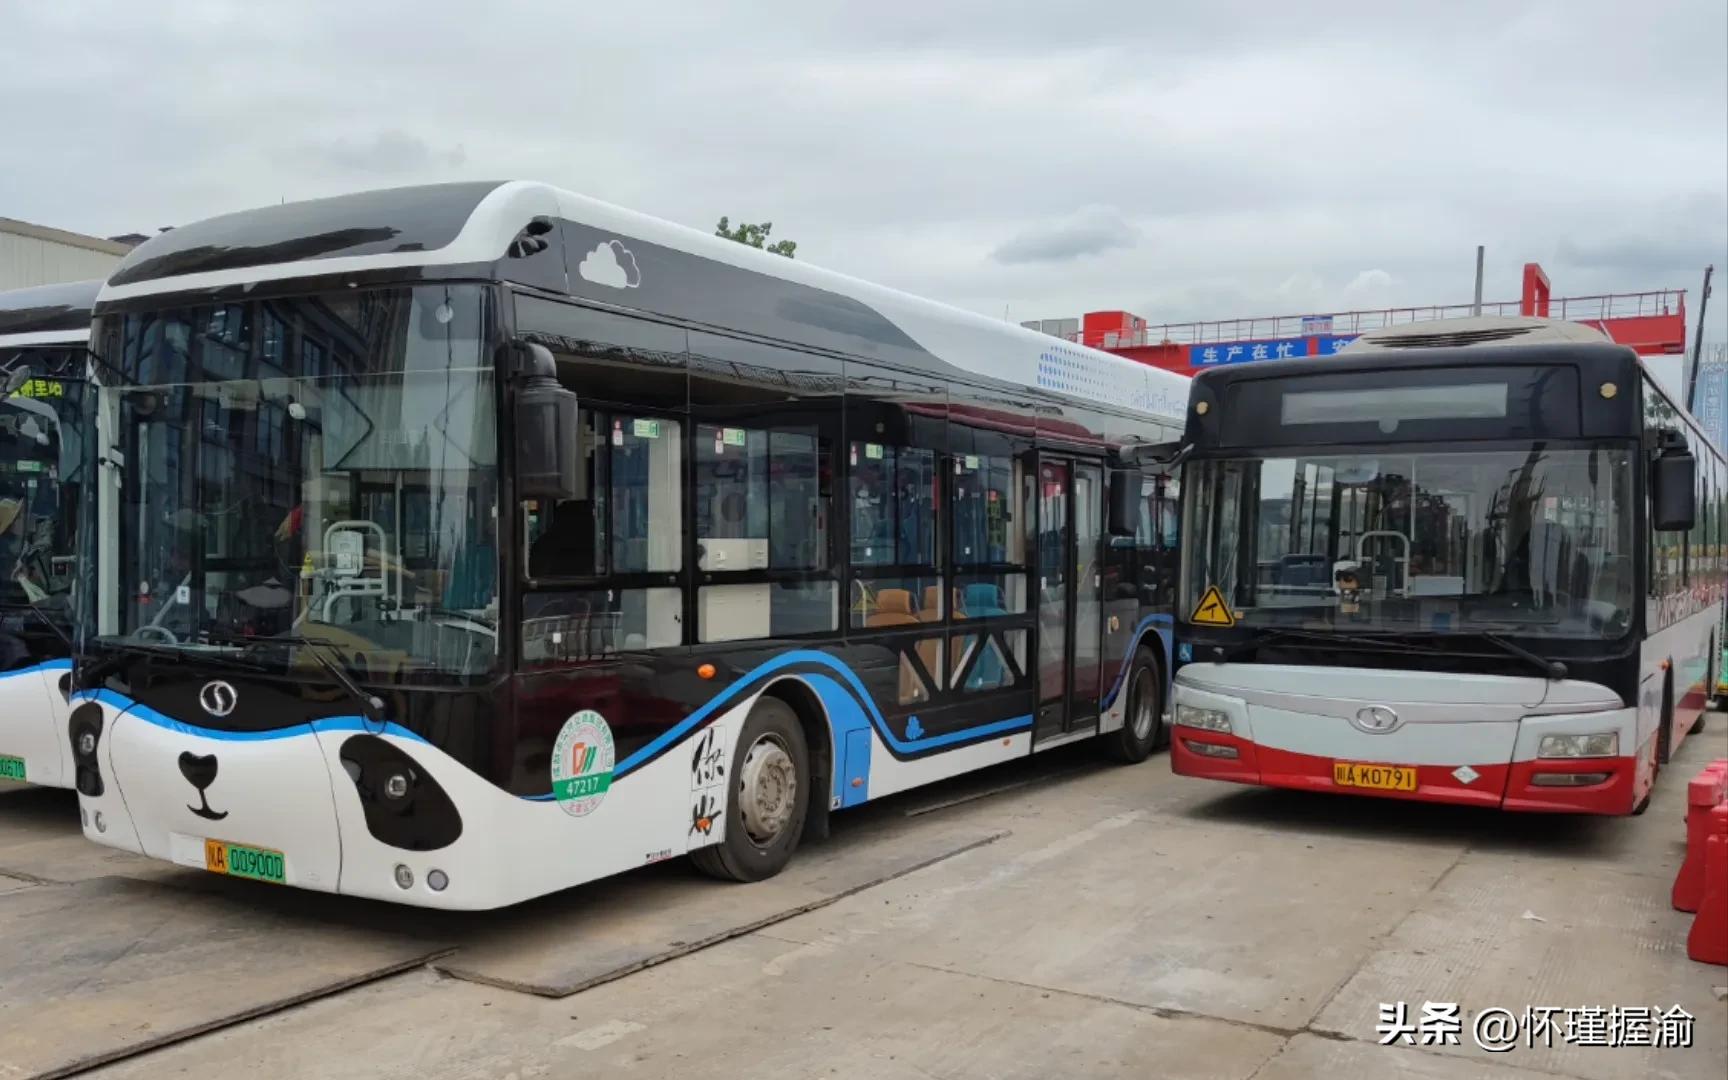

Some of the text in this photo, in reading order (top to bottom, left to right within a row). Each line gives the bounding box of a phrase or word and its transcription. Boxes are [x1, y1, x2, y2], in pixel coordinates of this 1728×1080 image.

[1202, 341, 1294, 363] 生产在忙
[566, 777, 599, 797] 47217
